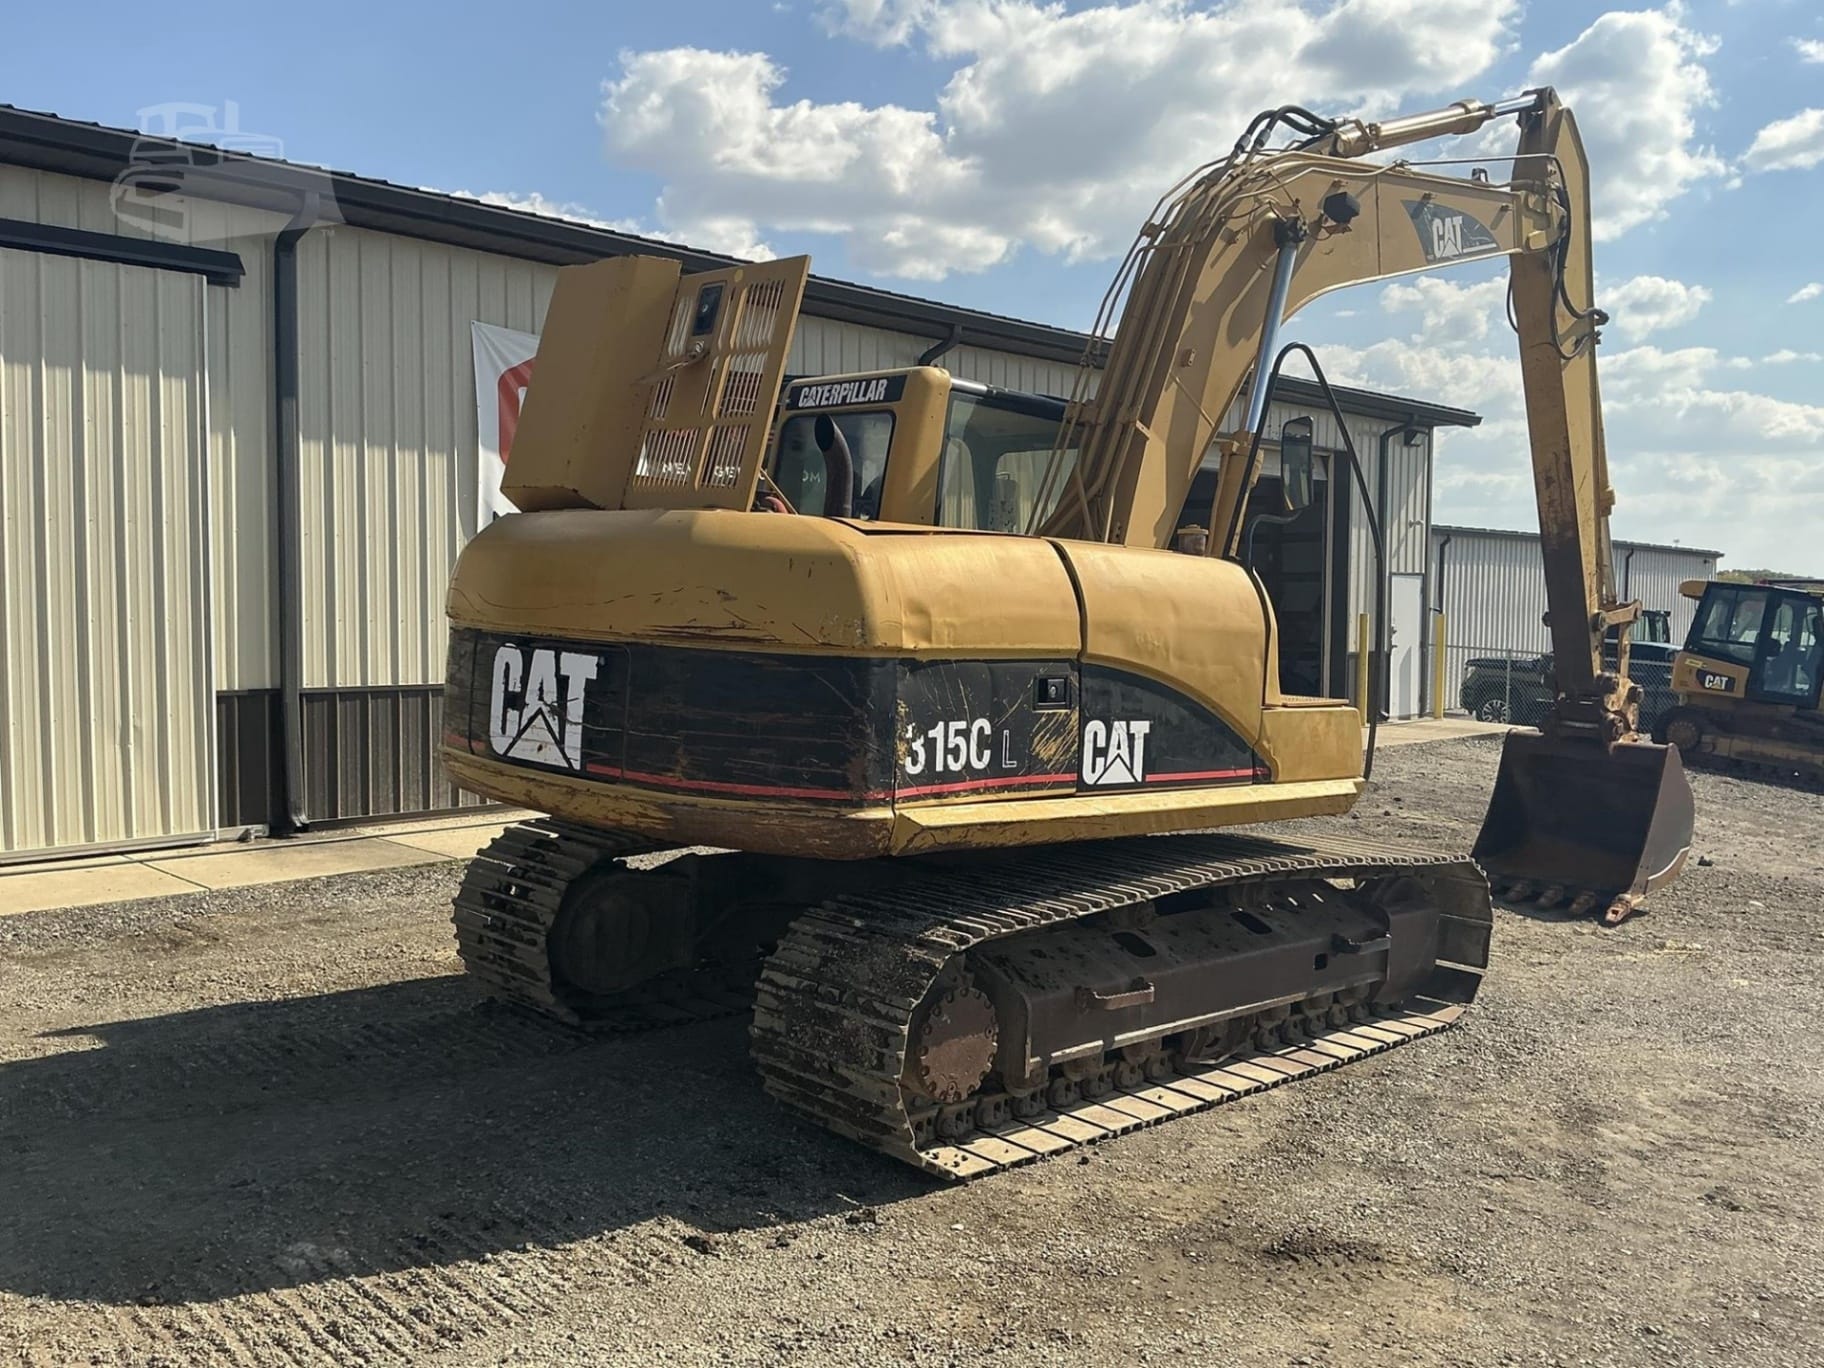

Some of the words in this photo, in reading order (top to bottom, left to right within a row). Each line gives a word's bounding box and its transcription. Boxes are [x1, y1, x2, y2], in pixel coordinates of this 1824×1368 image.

[1432, 215, 1463, 259] CAT
[798, 379, 888, 408] CATERPILLAR
[489, 643, 599, 770] CAT
[1704, 674, 1728, 690] CAT
[905, 718, 991, 775] 315C
[1002, 730, 1017, 768] L
[1081, 719, 1150, 785] CAT
